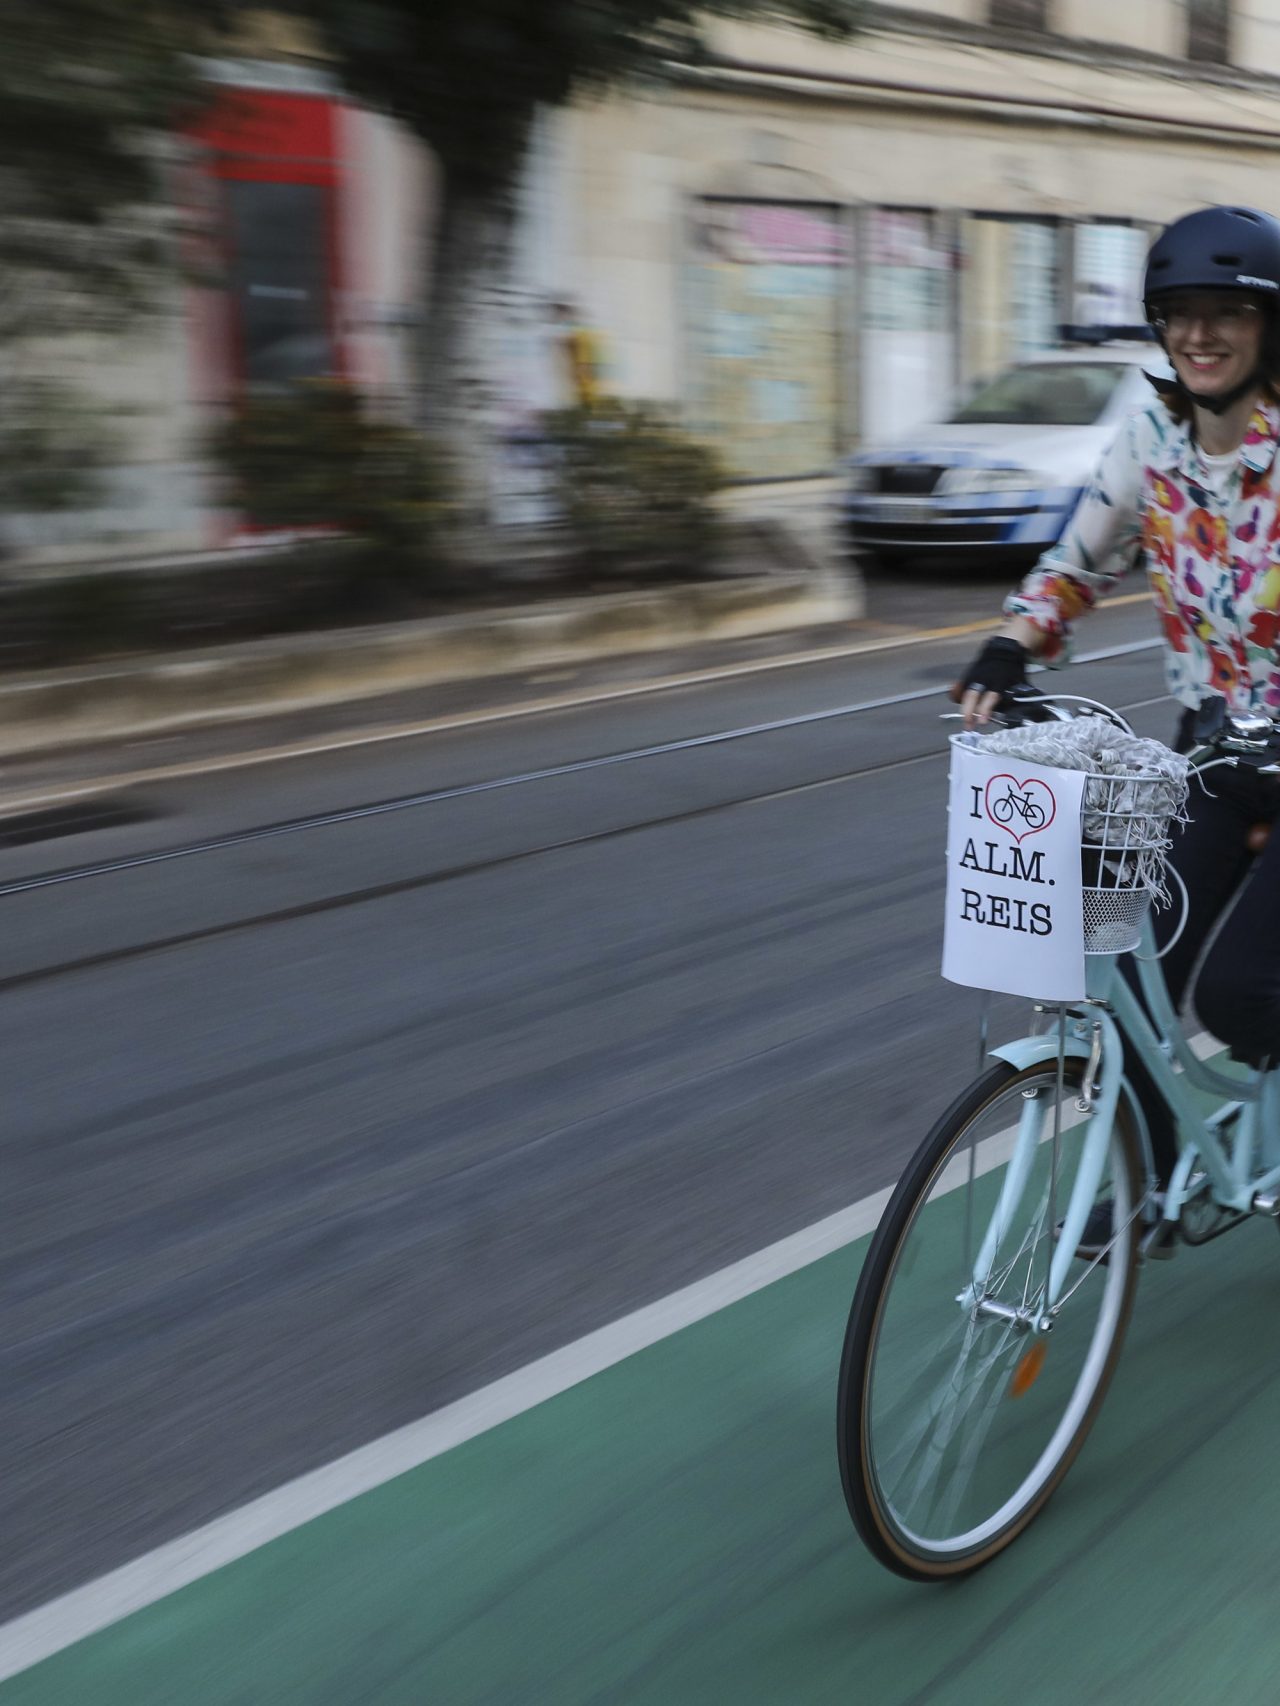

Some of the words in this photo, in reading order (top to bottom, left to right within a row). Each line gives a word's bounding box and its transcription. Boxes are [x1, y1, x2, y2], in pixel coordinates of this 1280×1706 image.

[969, 785, 983, 819] I
[959, 838, 1056, 886] ALM.
[960, 888, 1053, 936] REIS
